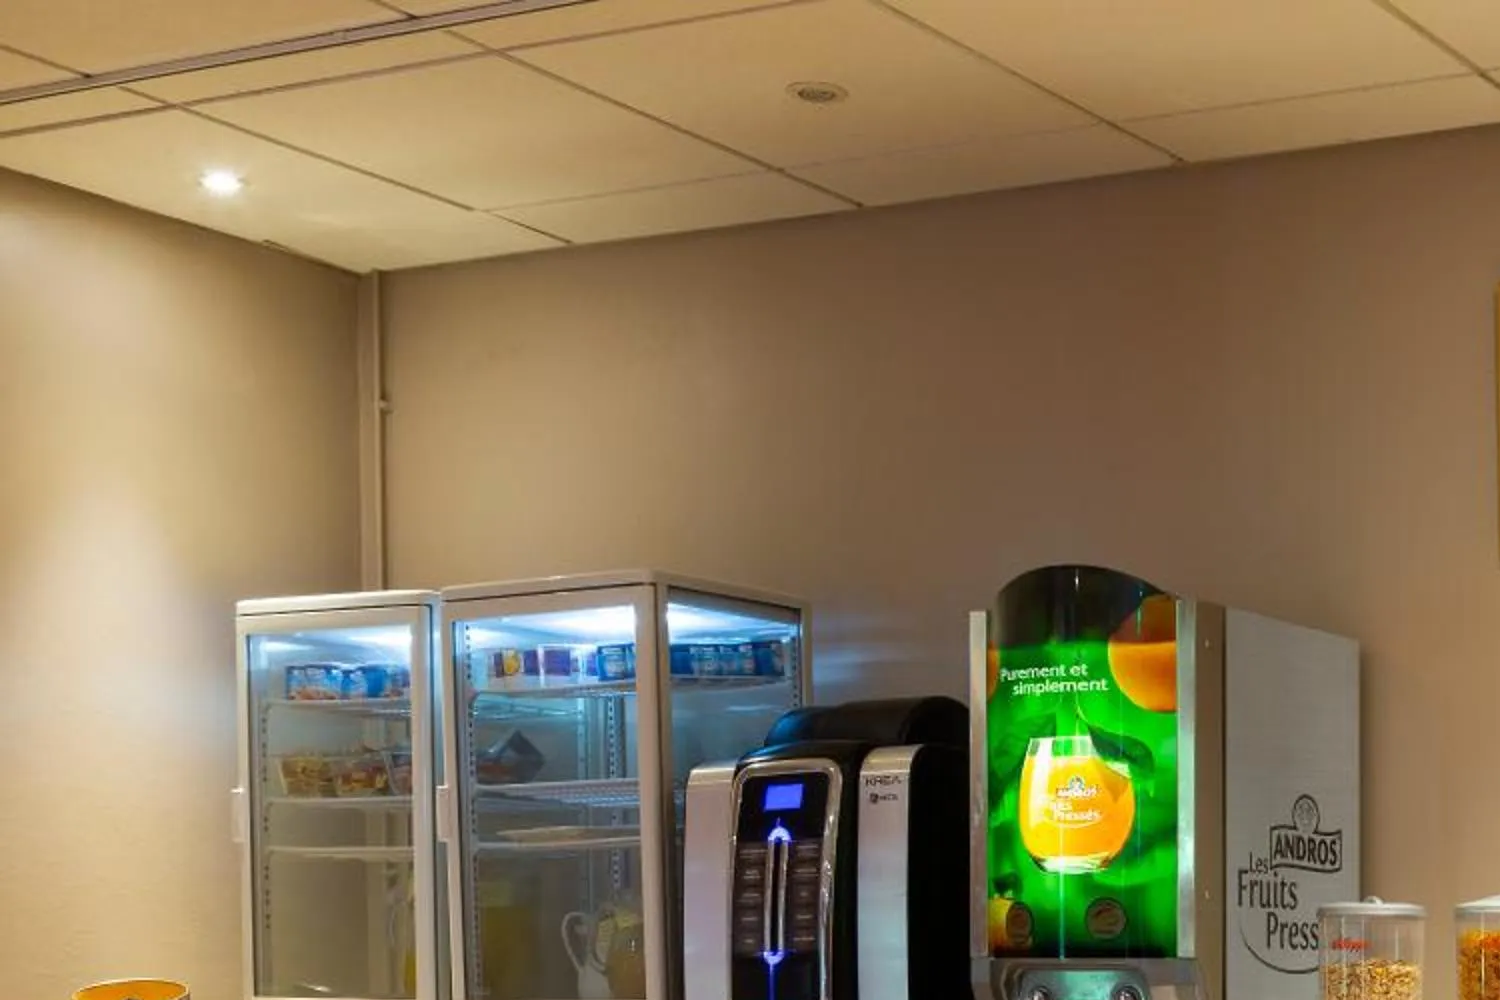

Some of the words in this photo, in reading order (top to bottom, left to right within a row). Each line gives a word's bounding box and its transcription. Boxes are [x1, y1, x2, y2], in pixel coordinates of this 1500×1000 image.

[1000, 664, 1066, 682] Purement
[1070, 663, 1088, 676] et
[1012, 678, 1109, 697] simplement
[1249, 851, 1269, 875] Les
[1273, 833, 1338, 866] ANDROS
[1237, 869, 1298, 910] Fruits
[1266, 911, 1319, 950] Press
